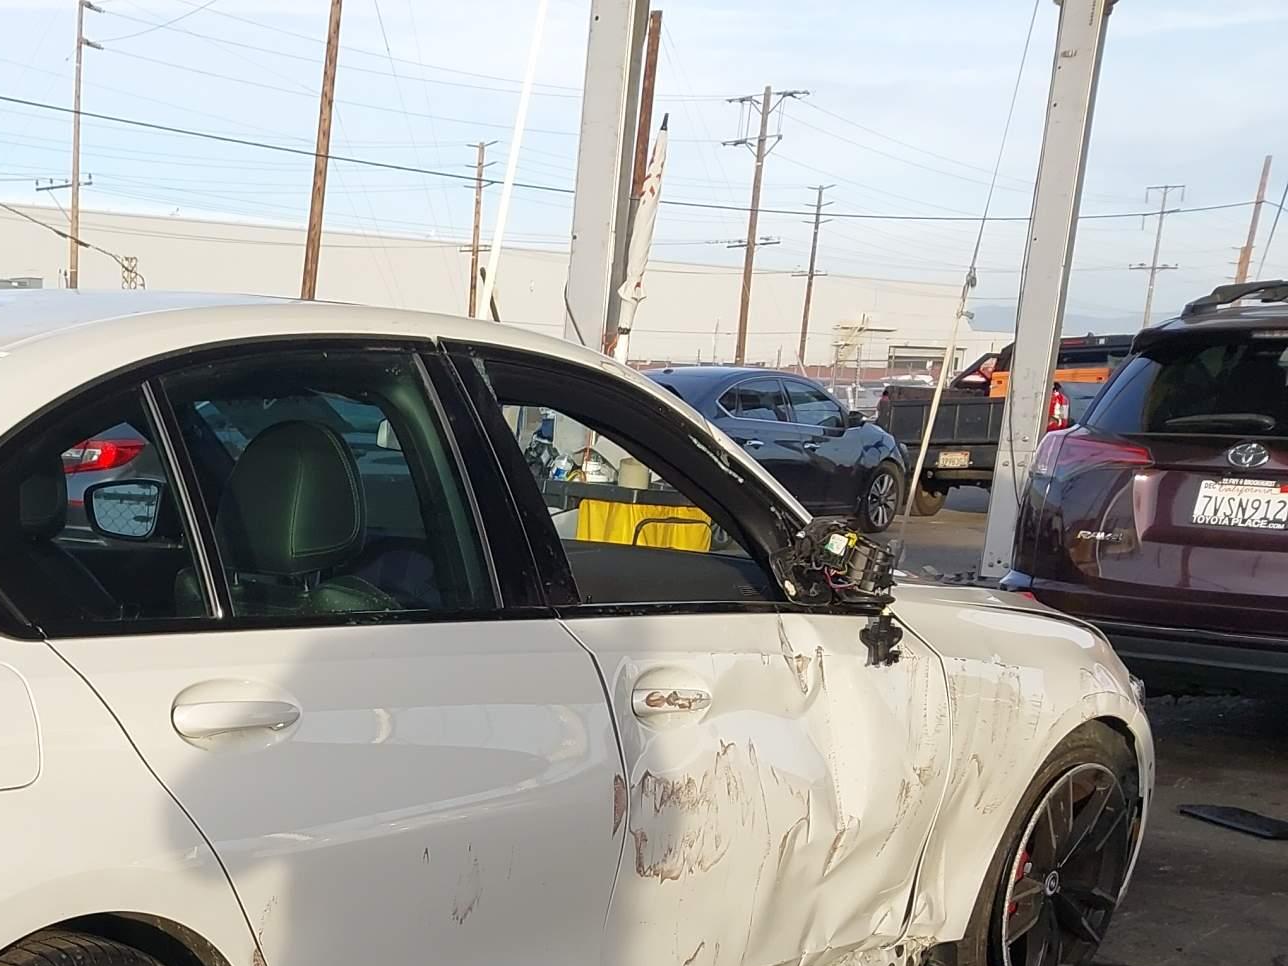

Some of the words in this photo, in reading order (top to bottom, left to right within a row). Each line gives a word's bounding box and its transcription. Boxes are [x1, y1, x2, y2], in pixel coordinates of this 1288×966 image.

[1218, 485, 1273, 496] California
[1202, 495, 1287, 520] 7VSN912
[1192, 514, 1229, 525] TOYOTA
